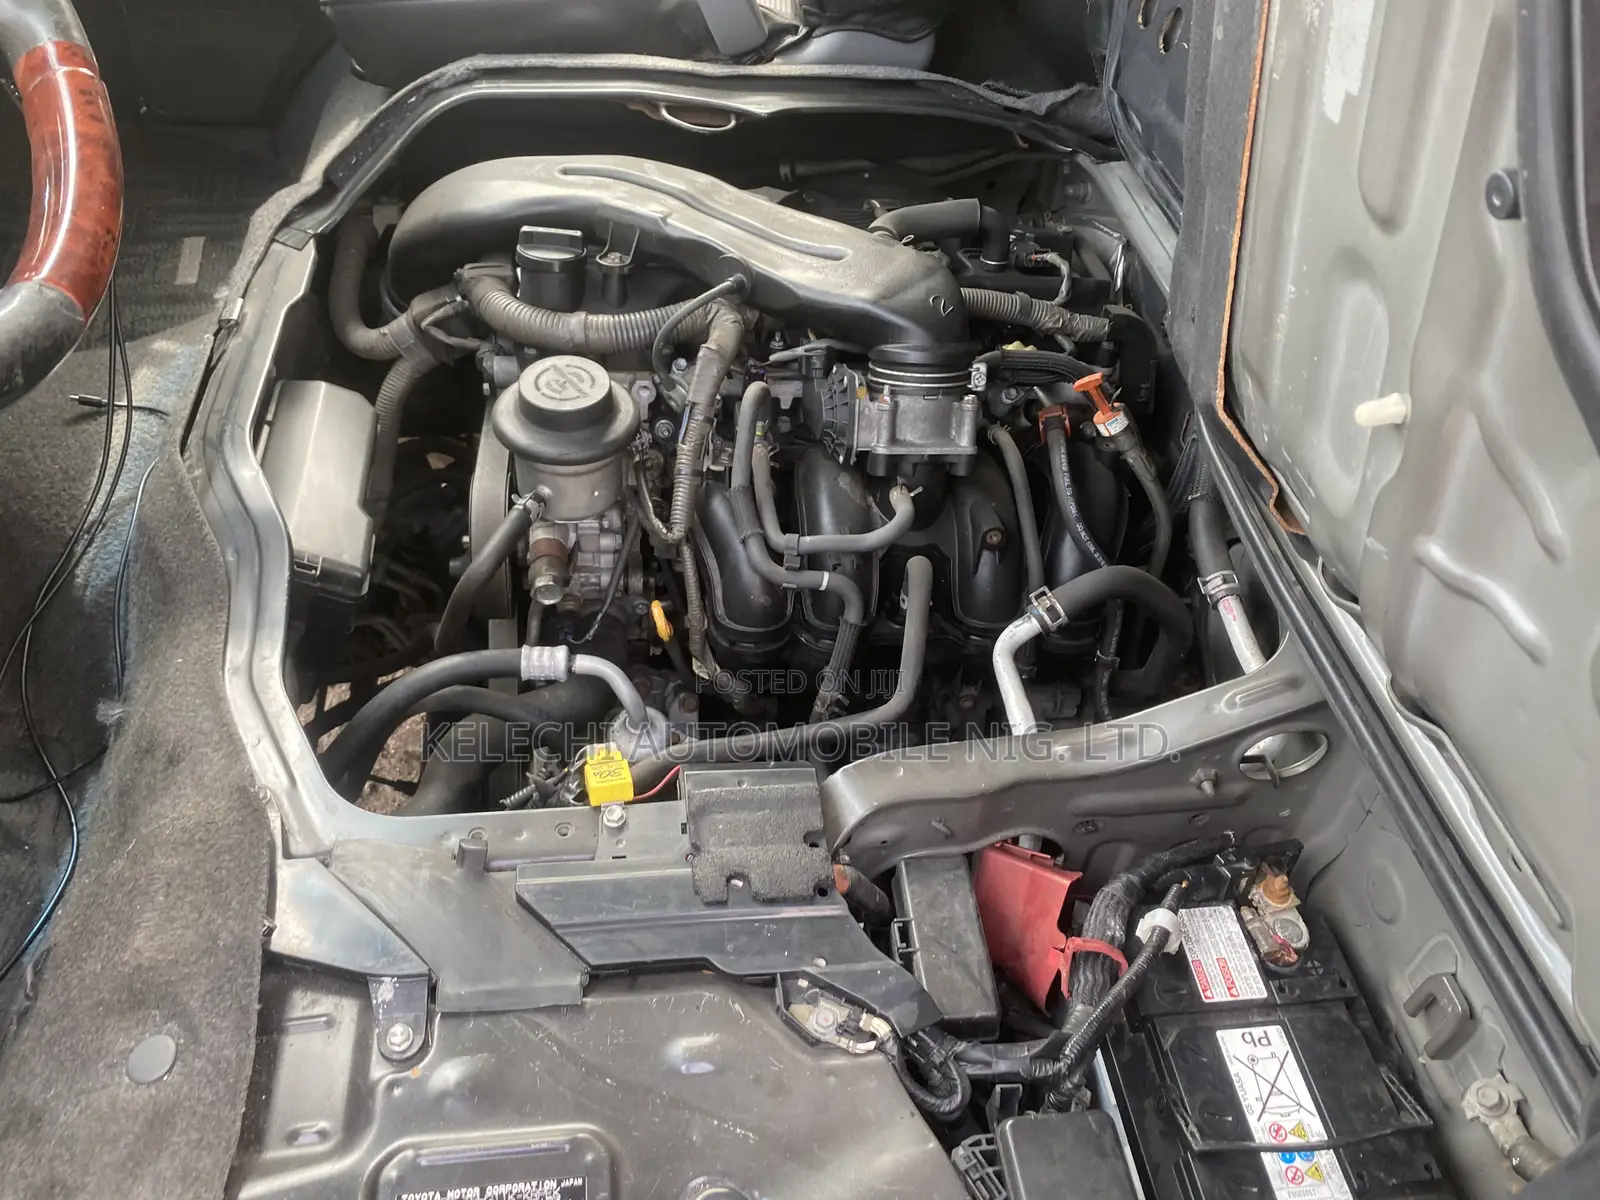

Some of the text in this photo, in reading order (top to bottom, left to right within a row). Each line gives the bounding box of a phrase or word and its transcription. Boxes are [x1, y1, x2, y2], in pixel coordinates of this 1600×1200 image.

[930, 294, 954, 317] 2
[1241, 1030, 1273, 1048] Pb
[401, 1191, 441, 1200] TOYOTA
[446, 1187, 480, 1200] MOTOR
[485, 1179, 558, 1196] CORPORATION
[561, 1177, 583, 1188] JAPAN
